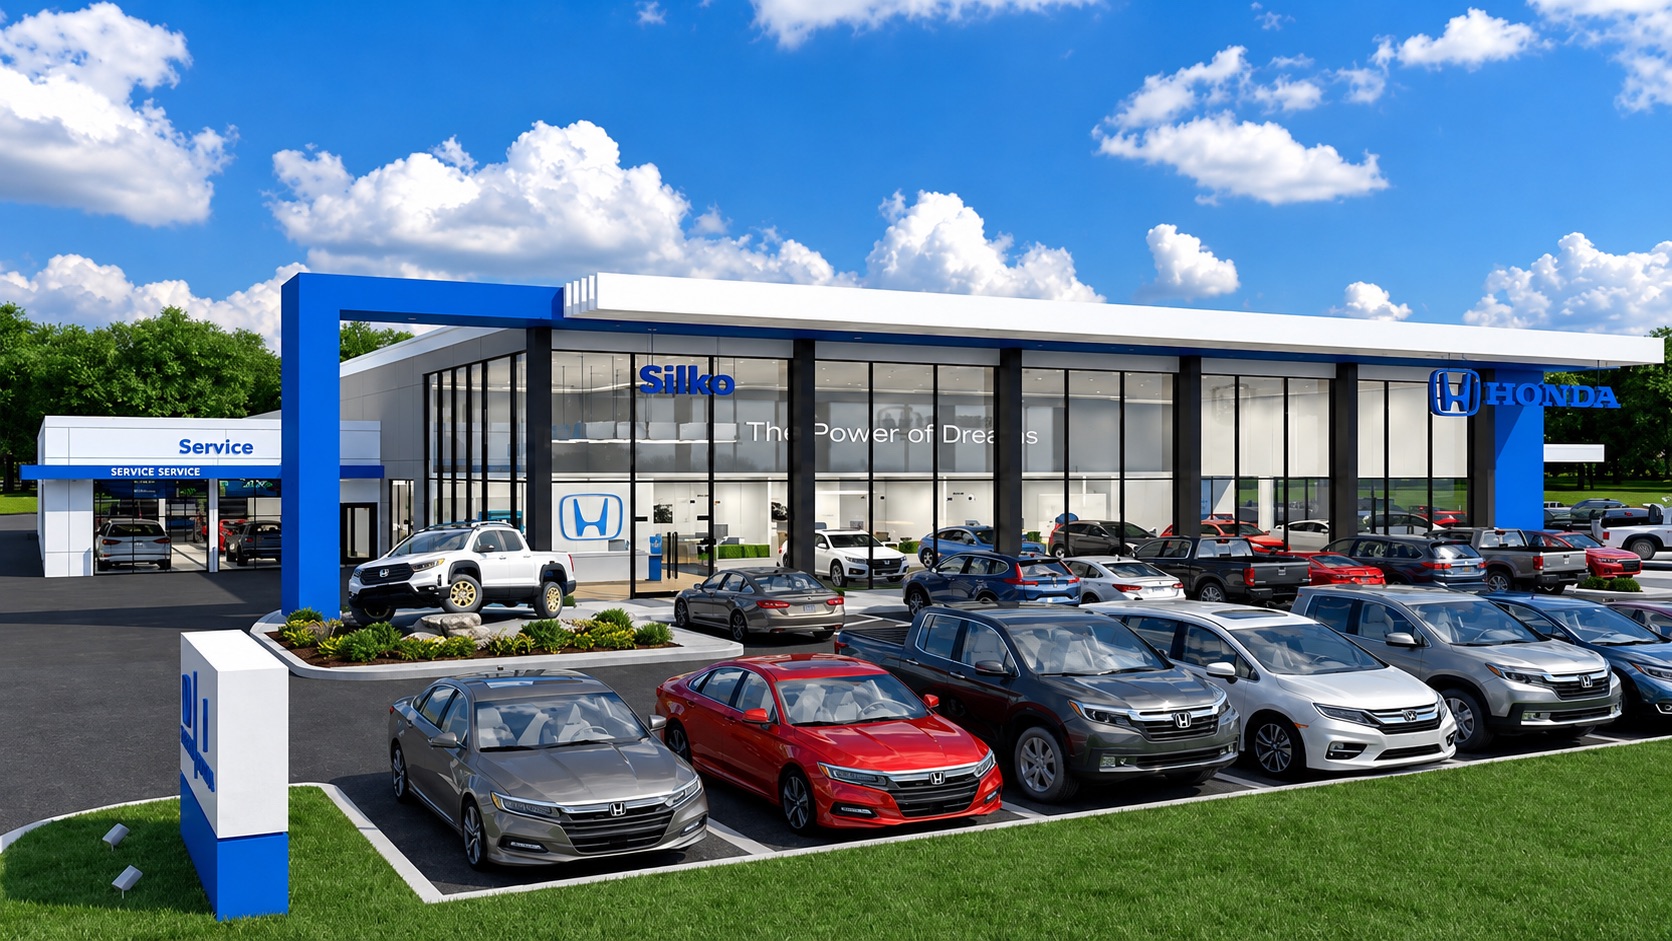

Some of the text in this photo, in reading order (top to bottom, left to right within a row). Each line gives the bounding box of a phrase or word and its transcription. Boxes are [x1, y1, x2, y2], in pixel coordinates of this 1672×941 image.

[639, 364, 736, 396] Silko
[1484, 381, 1622, 409] HONDA
[814, 422, 900, 444] Power
[907, 423, 935, 444] of
[943, 424, 1039, 445] Dreas
[178, 438, 254, 455] Service
[110, 467, 201, 477] SERVICE SERVICE
